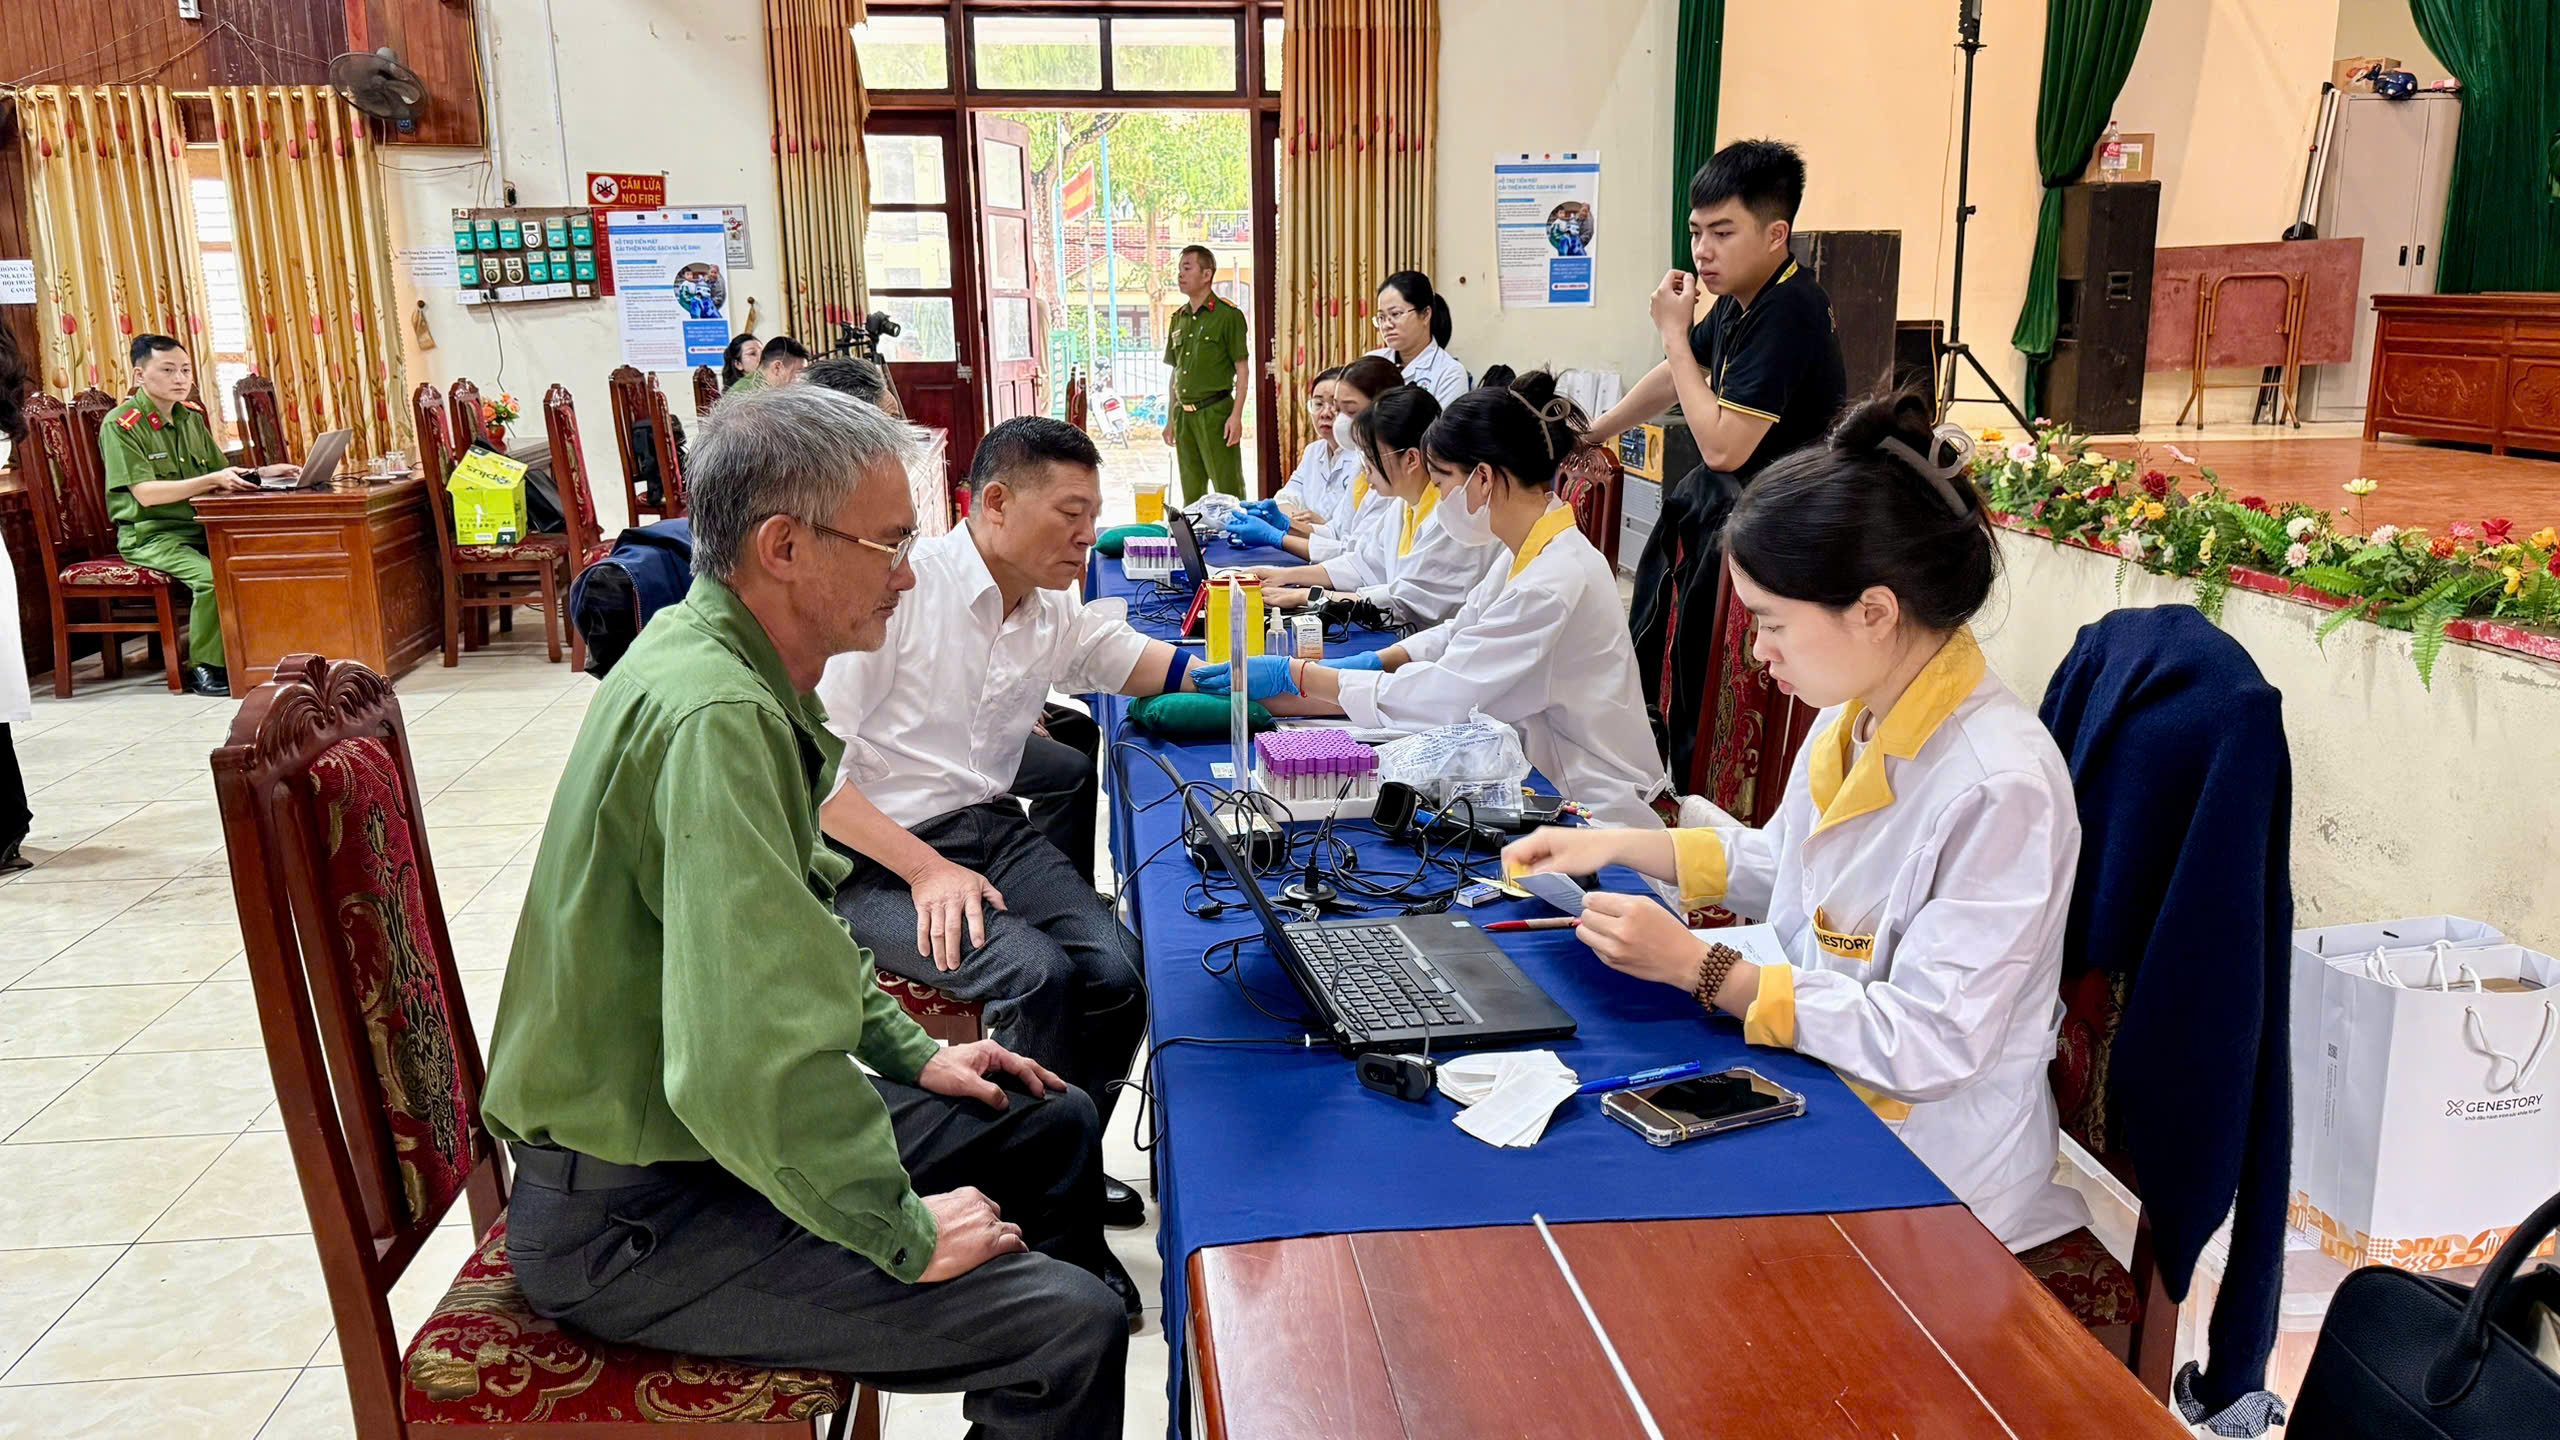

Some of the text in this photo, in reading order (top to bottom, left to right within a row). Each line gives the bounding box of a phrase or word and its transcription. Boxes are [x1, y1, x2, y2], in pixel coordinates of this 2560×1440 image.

[620, 176, 662, 191] CẤM LỬA
[621, 193, 662, 205] NO FIRE
[1816, 932, 1871, 950] NESTORY
[2466, 1094, 2544, 1113] GENESTORY
